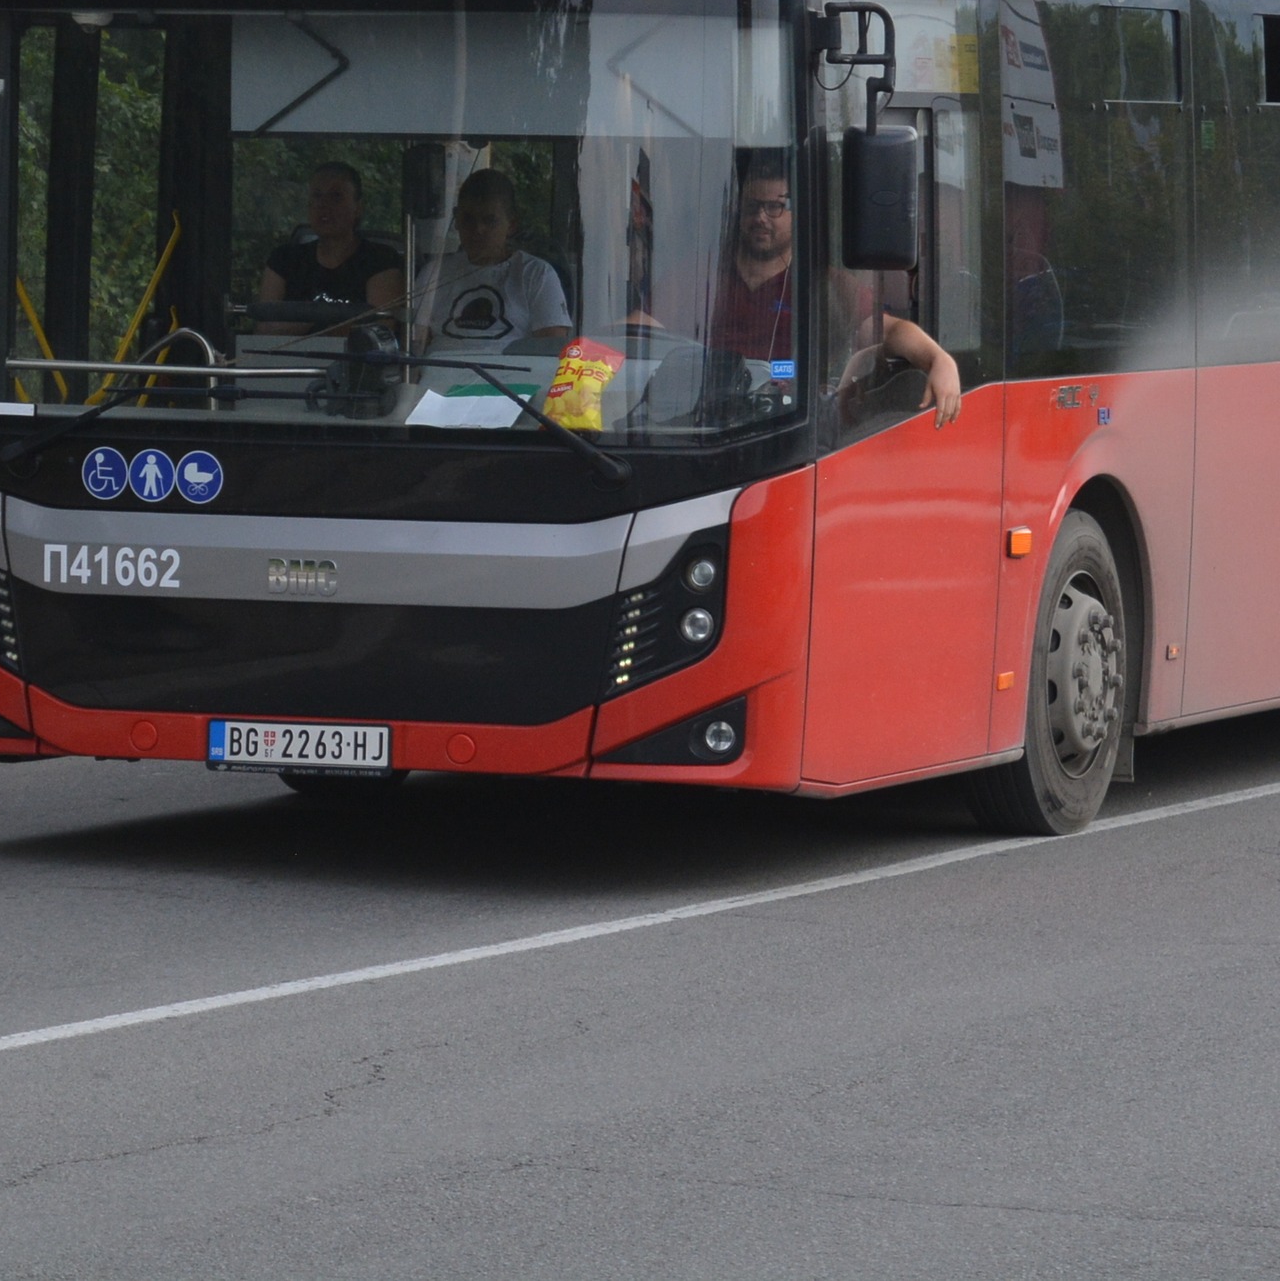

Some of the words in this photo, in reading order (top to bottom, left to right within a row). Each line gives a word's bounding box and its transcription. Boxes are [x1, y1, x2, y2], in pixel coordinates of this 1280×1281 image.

[556, 360, 606, 383] chips
[43, 543, 181, 588] П41662
[268, 557, 337, 597] BMC
[229, 727, 259, 757] BG
